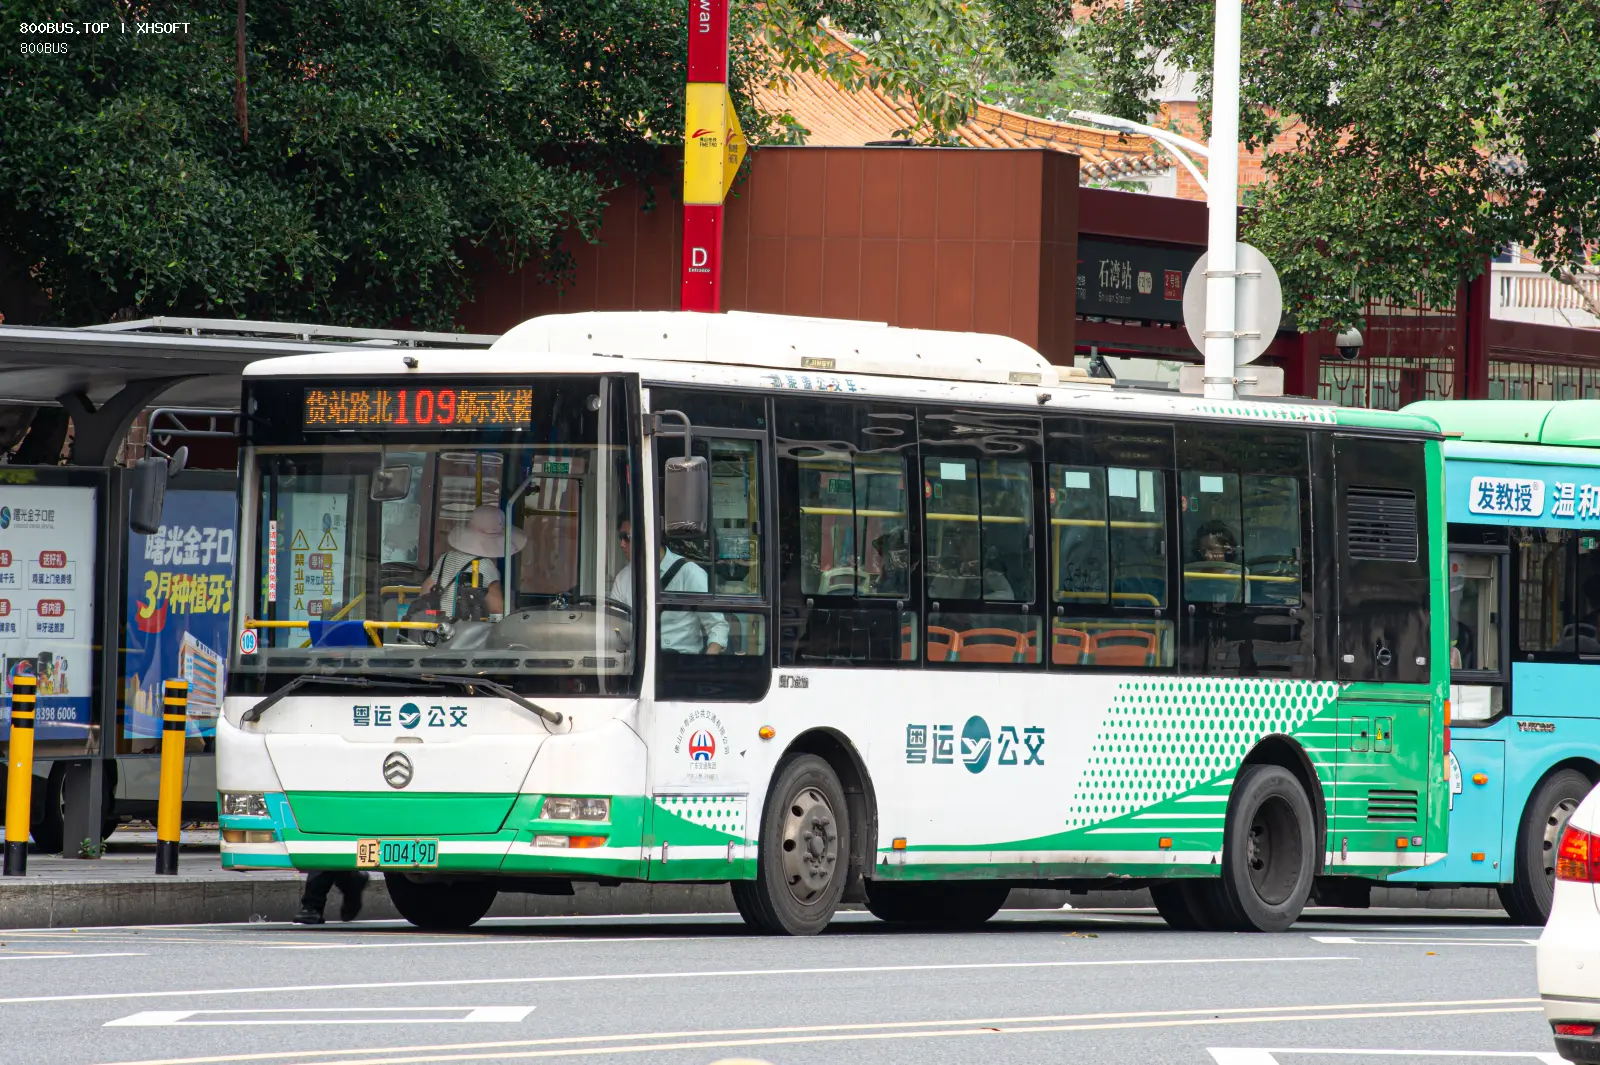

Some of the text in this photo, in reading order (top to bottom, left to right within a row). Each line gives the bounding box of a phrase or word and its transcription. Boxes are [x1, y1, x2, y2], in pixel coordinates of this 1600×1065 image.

[692, 247, 708, 267] D
[1099, 259, 1132, 290] 石湾站
[810, 360, 834, 369] JINGYI
[305, 390, 393, 425] 货站路北
[394, 389, 458, 425] 109
[1477, 481, 1600, 519] 发教授 温和
[13, 508, 55, 522] 曙光金子口腔
[144, 525, 233, 567] 曙光金子口
[242, 631, 254, 648] 109
[36, 707, 77, 720] 8398 6006
[353, 705, 468, 727] 粤运 公交
[906, 723, 1045, 765] 粤运 公交
[359, 843, 436, 863] 粤E 00419D
